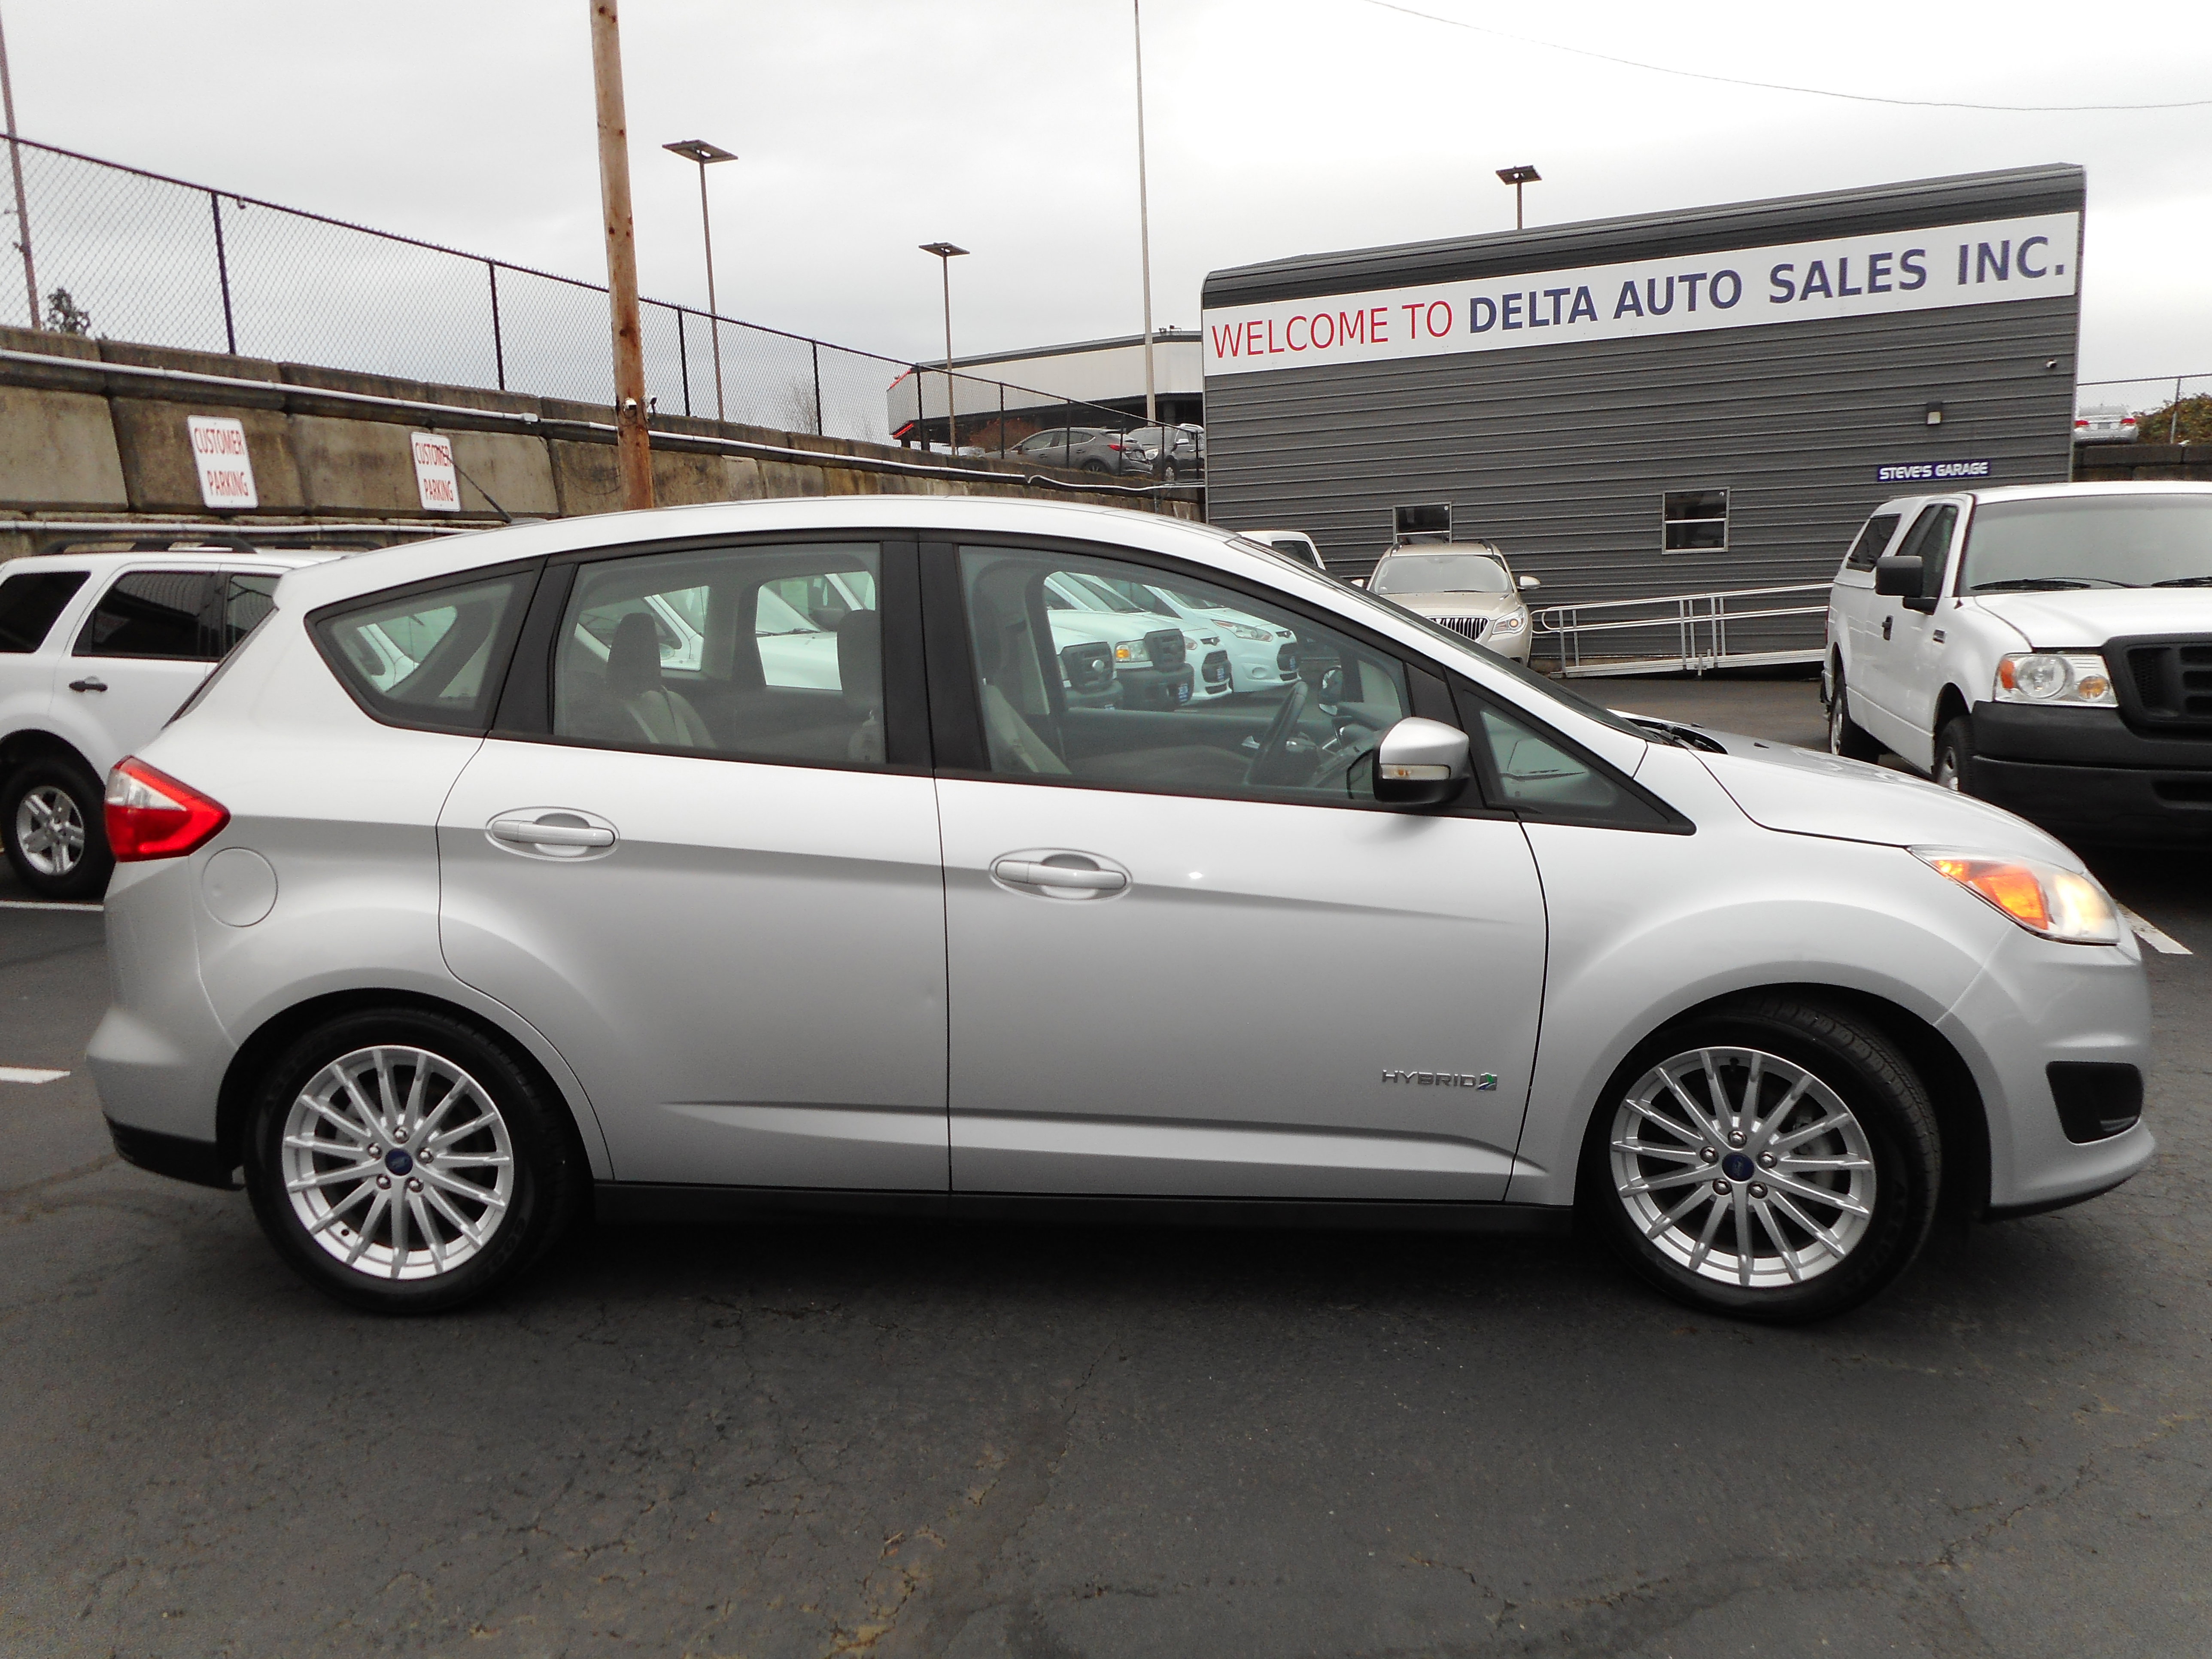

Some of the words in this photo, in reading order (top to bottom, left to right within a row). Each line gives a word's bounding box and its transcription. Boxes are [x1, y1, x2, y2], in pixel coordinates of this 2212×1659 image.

[1212, 307, 1389, 359] WELCOME
[1401, 301, 1452, 339] TO
[1469, 286, 1598, 334] DELTA
[1613, 270, 1742, 319] AUTO
[1769, 249, 1927, 304] SALES
[1957, 236, 2064, 286] INC.
[194, 427, 246, 456] CUSTOMER
[415, 442, 452, 467] CUSTOMER
[207, 469, 249, 497] PARKING
[1879, 465, 1932, 480] STEVE'S
[1935, 462, 1989, 477] GARAGE
[423, 478, 454, 502] PARKING
[1382, 1069, 1477, 1087] HYBRID
